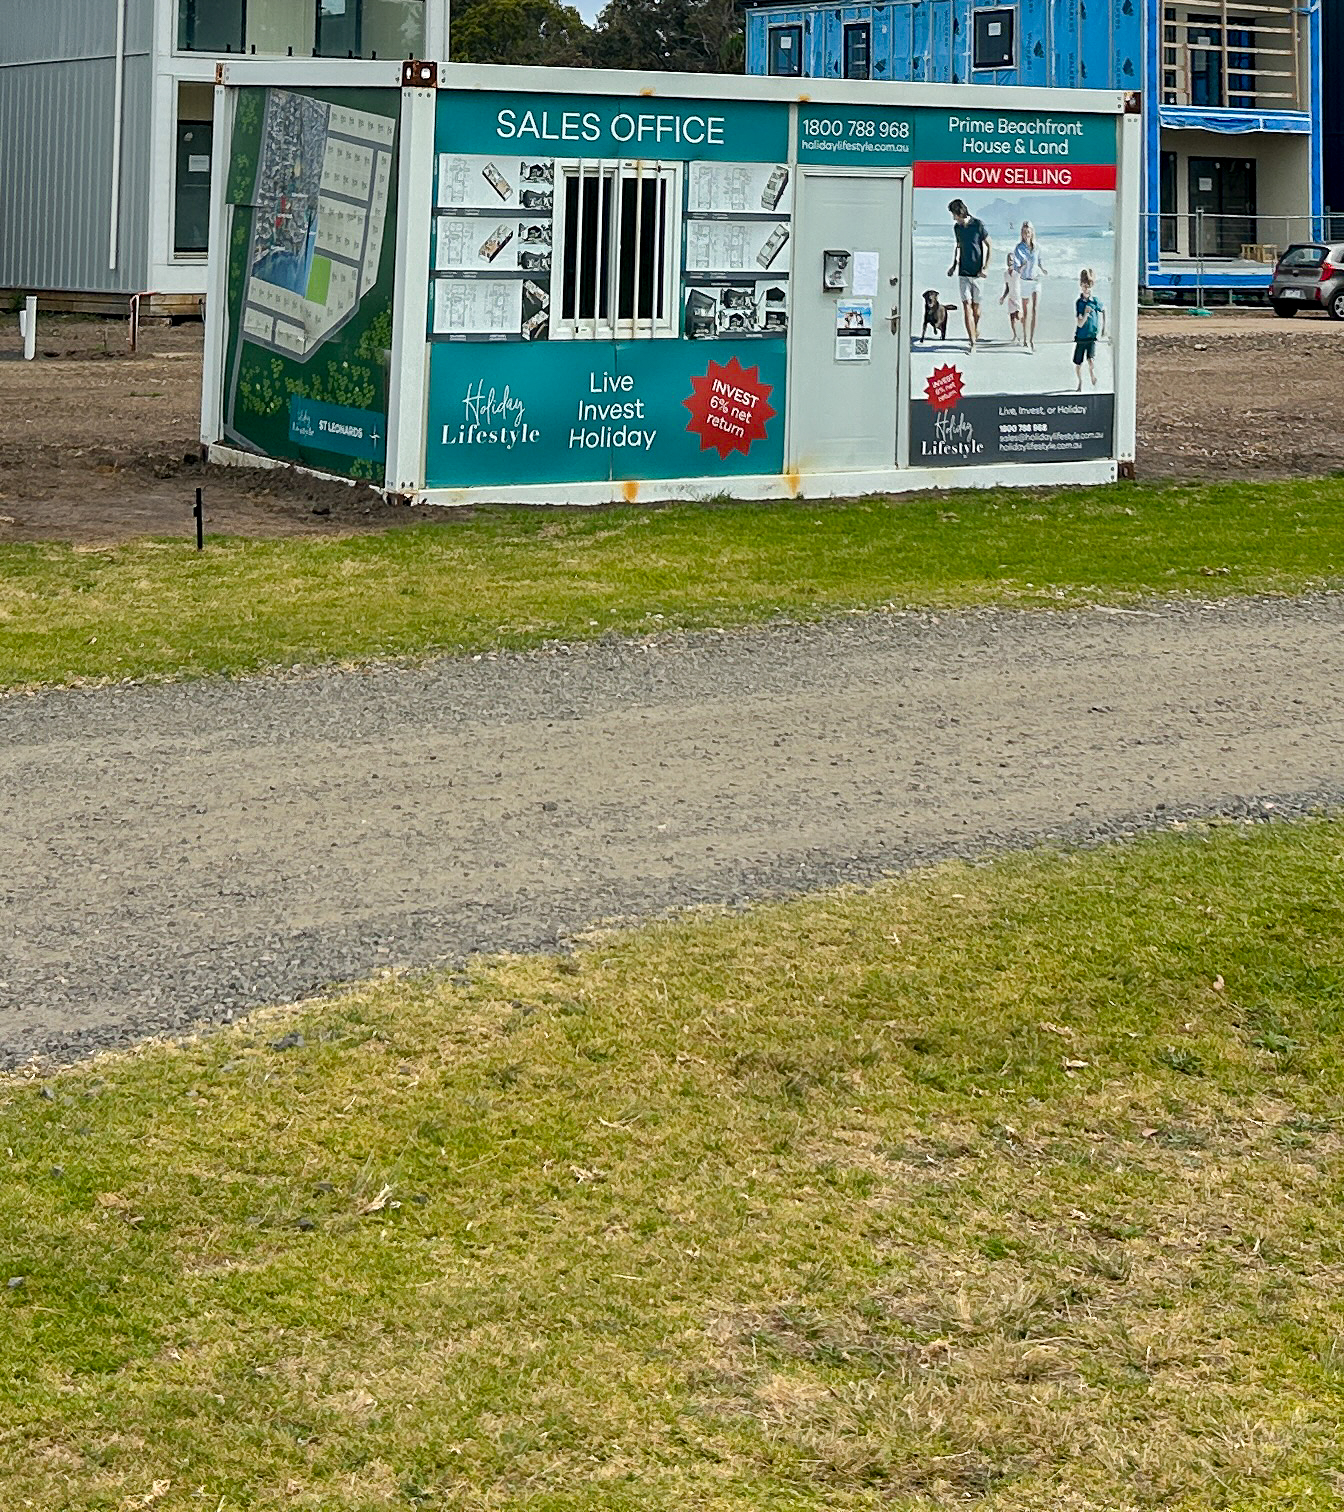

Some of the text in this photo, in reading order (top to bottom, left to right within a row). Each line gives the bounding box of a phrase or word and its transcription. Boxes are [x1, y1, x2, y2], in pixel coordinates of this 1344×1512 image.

[496, 109, 725, 145] SALES OFFICE
[802, 119, 910, 138] 1800 788 968
[948, 117, 1084, 136] Prime Beachfront
[801, 139, 910, 152] holidaylifestyle.com.au
[962, 138, 1069, 155] House & Land
[960, 167, 1072, 185] NOW SELLING
[590, 371, 634, 393] Live
[462, 379, 526, 427] Holiday
[711, 378, 760, 409] INVEST
[578, 399, 645, 421] Invest
[710, 395, 753, 424] 6% net
[1046, 406, 1056, 415] or
[1057, 404, 1088, 415] Holiday
[440, 423, 541, 450] Lifestyle
[706, 413, 745, 438] return
[934, 409, 974, 443] Holiday
[568, 425, 657, 451] Holiday
[921, 438, 984, 459] Lifestyle
